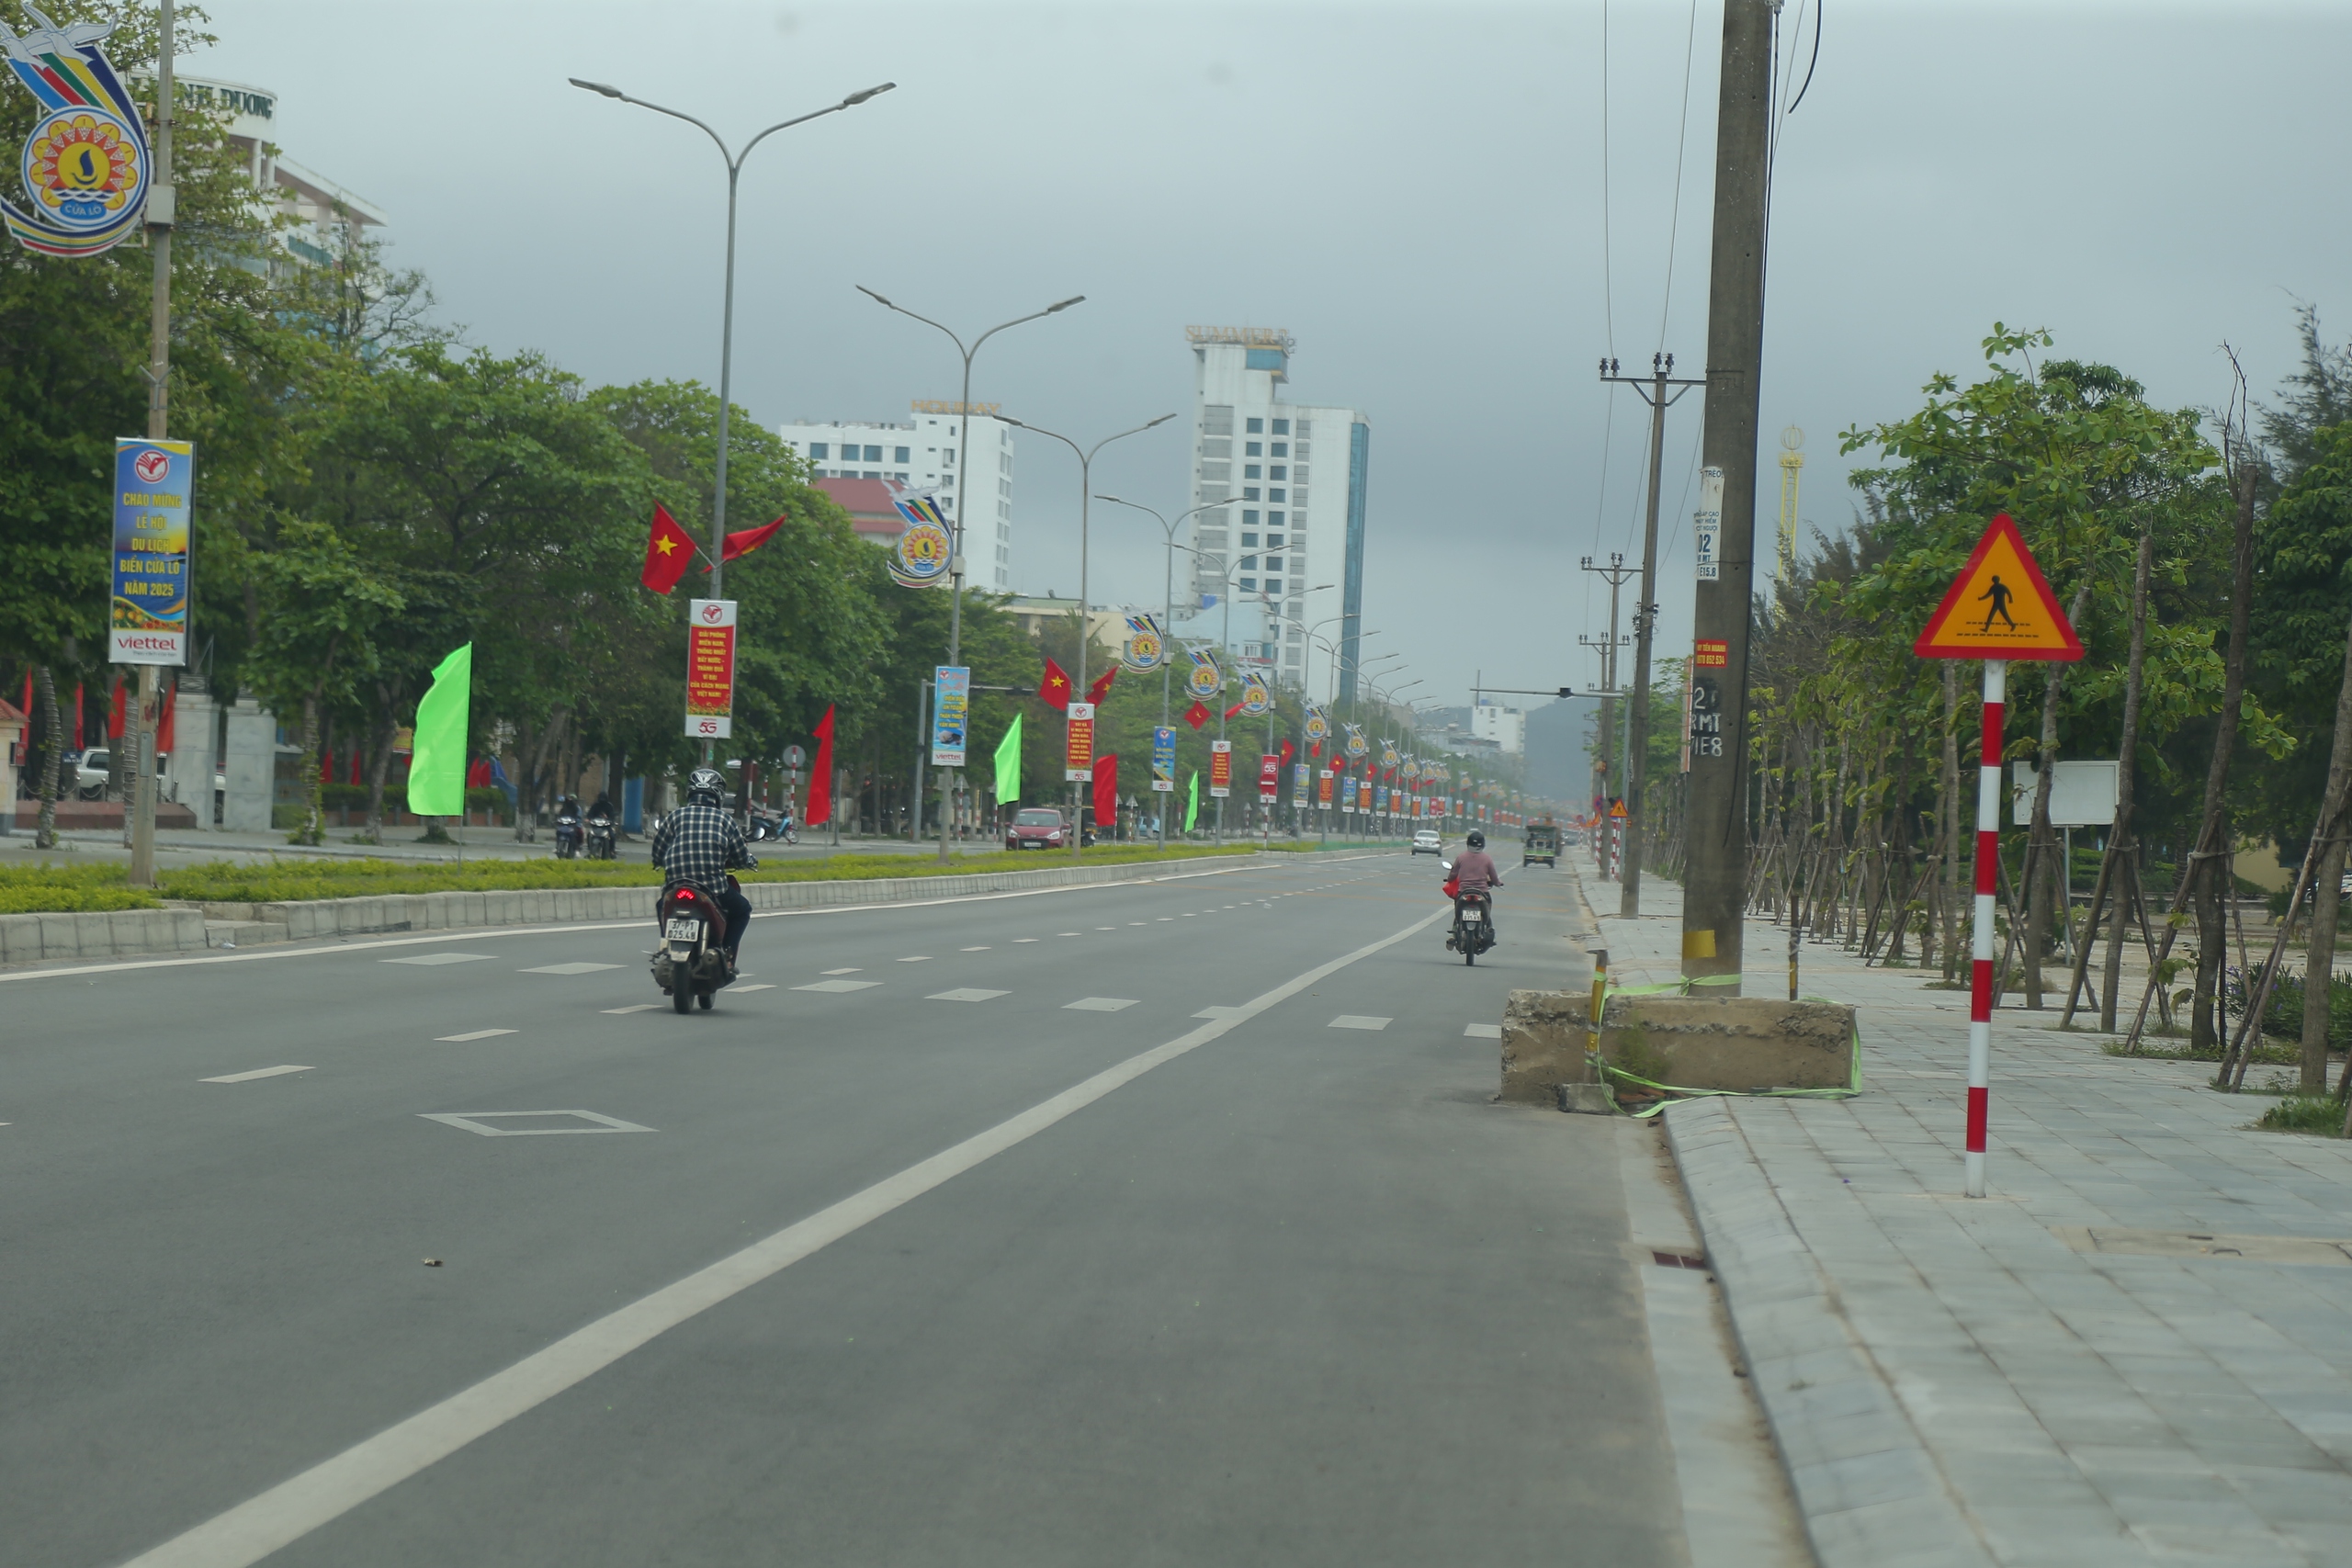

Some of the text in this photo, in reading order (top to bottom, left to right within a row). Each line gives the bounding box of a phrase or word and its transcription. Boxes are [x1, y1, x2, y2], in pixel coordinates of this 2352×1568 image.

[1185, 324, 1277, 345] SUMMER
[910, 399, 1001, 416] HOLIDAY
[123, 491, 182, 509] CHÀO MỪNG
[131, 537, 170, 555] DU LỊCH
[145, 556, 165, 574] CỬA
[124, 580, 175, 598] NĂM 2025
[118, 636, 177, 651] viettel
[698, 721, 717, 734] 5G
